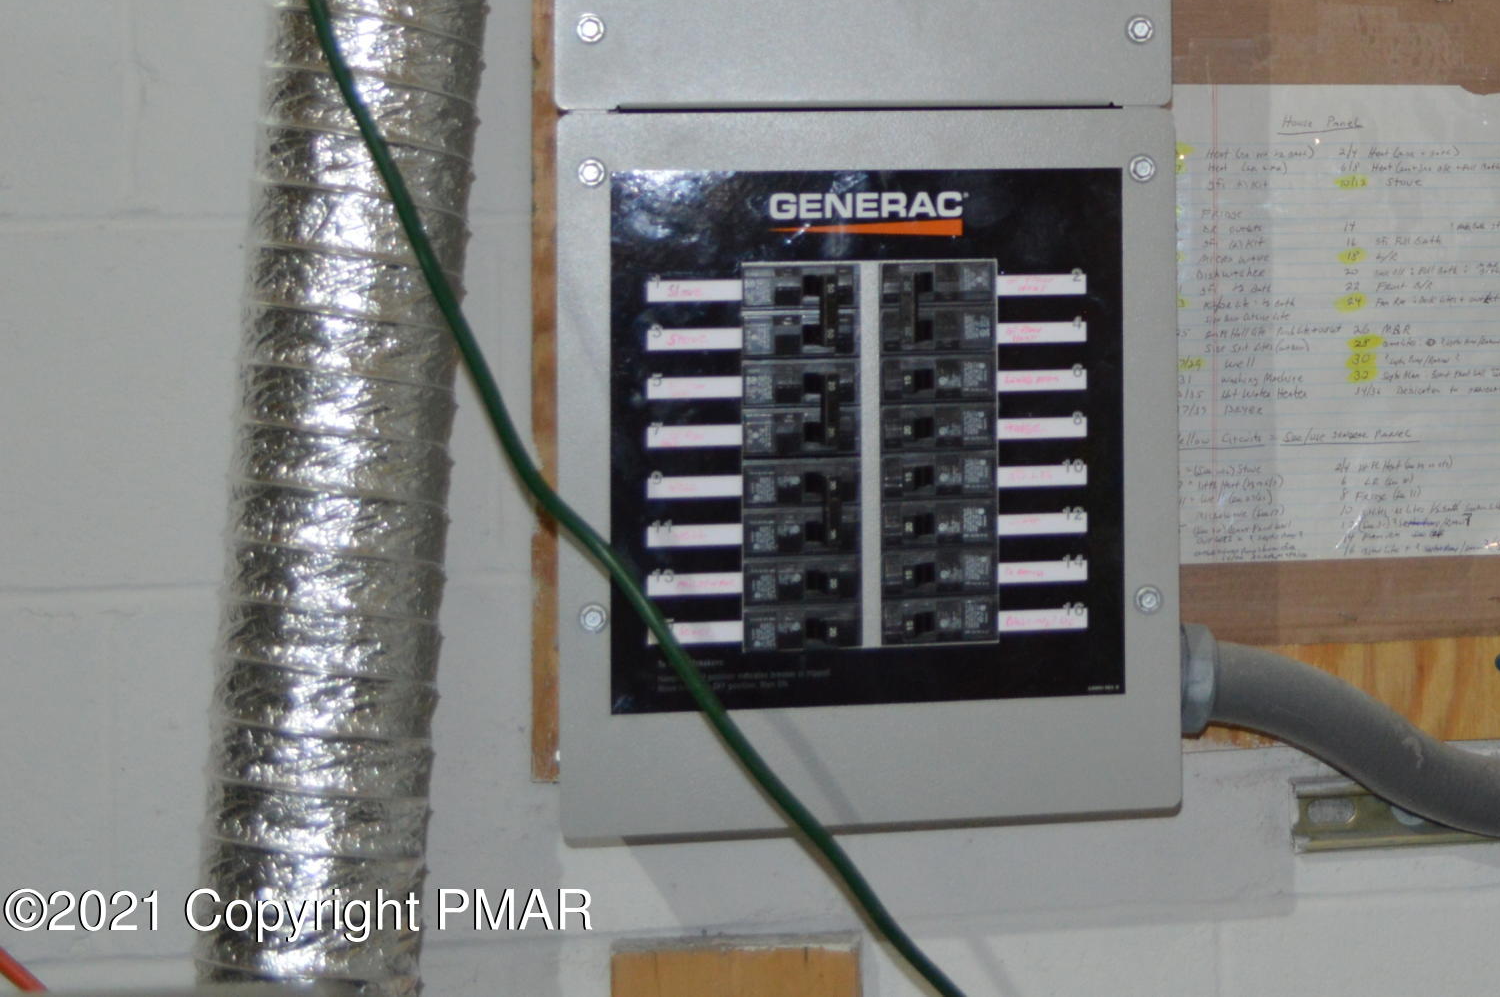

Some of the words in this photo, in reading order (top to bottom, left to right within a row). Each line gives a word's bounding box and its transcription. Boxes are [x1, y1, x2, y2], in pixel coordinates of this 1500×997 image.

[769, 191, 964, 220] GENERAC
[1072, 315, 1083, 330] 4
[652, 323, 664, 338] 3
[1072, 363, 1083, 378] 6
[652, 373, 663, 387] 5
[1073, 411, 1084, 425] 8
[652, 422, 663, 436] 7
[1062, 459, 1084, 473] 10
[1062, 506, 1084, 521] 12
[652, 519, 673, 533] 11
[1062, 554, 1084, 569] 14
[652, 569, 675, 583] 13
[1062, 602, 1085, 617] 16
